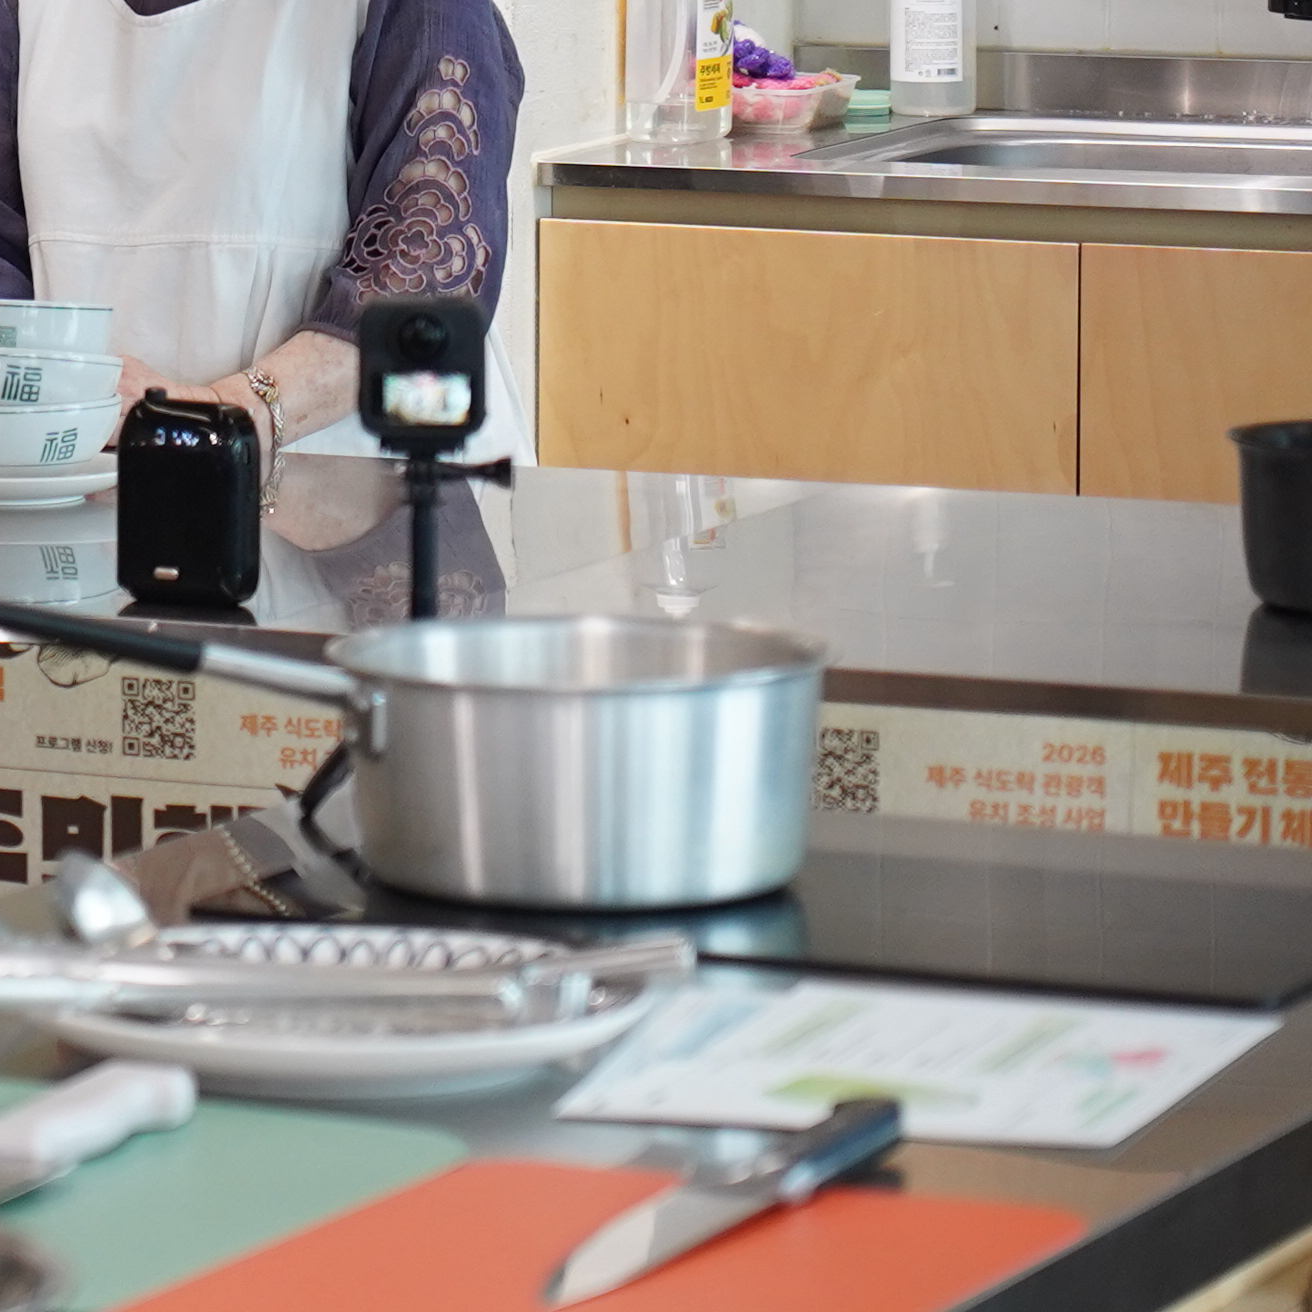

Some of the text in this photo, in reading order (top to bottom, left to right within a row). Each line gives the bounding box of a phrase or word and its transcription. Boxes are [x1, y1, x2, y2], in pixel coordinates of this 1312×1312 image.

[1, 365, 42, 403] 福
[40, 428, 78, 463] 福
[36, 735, 82, 752] 프로그램
[240, 714, 342, 743] 제주 식도락
[279, 746, 319, 771] 유치
[1042, 741, 1107, 766] 2026
[926, 764, 1107, 799] 제주 식도락 관광객
[1158, 751, 1312, 800] 제주 전통
[968, 799, 1107, 833] 유치 조성 사업
[1158, 799, 1271, 846] 만들기
